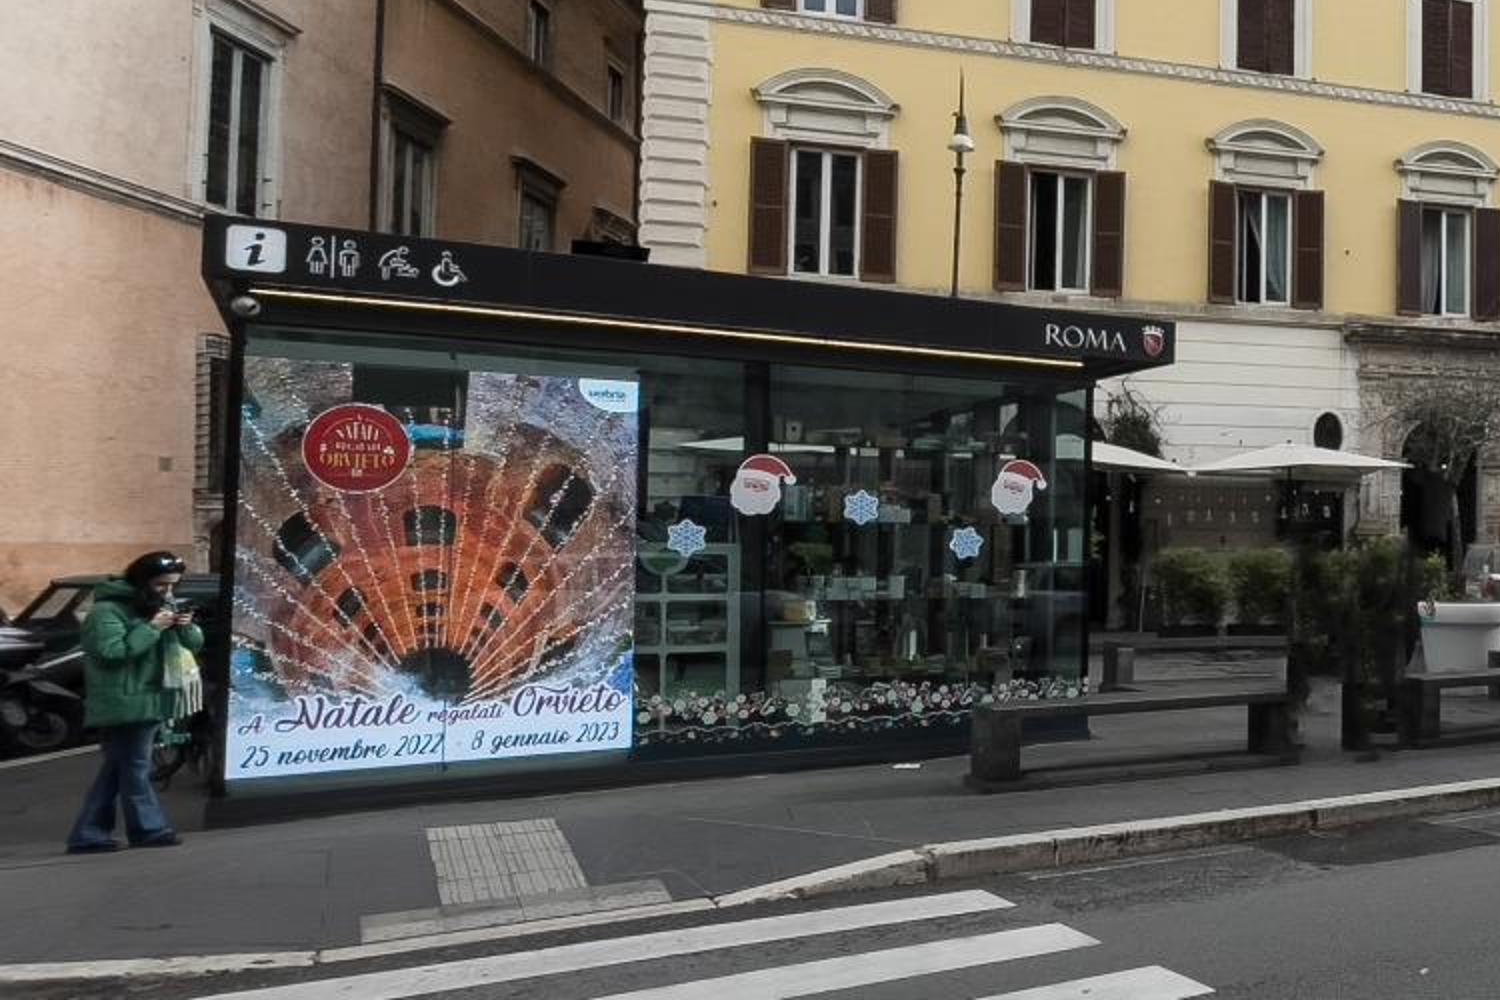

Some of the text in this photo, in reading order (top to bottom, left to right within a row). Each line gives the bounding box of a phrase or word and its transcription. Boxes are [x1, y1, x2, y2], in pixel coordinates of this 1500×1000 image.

[1045, 323, 1127, 353] ROMA
[319, 452, 396, 469] ORVIETO
[238, 682, 626, 736] A Natale regalati Orvieto
[240, 721, 621, 769] 25 novembre 2022 8 gennaio 2023
